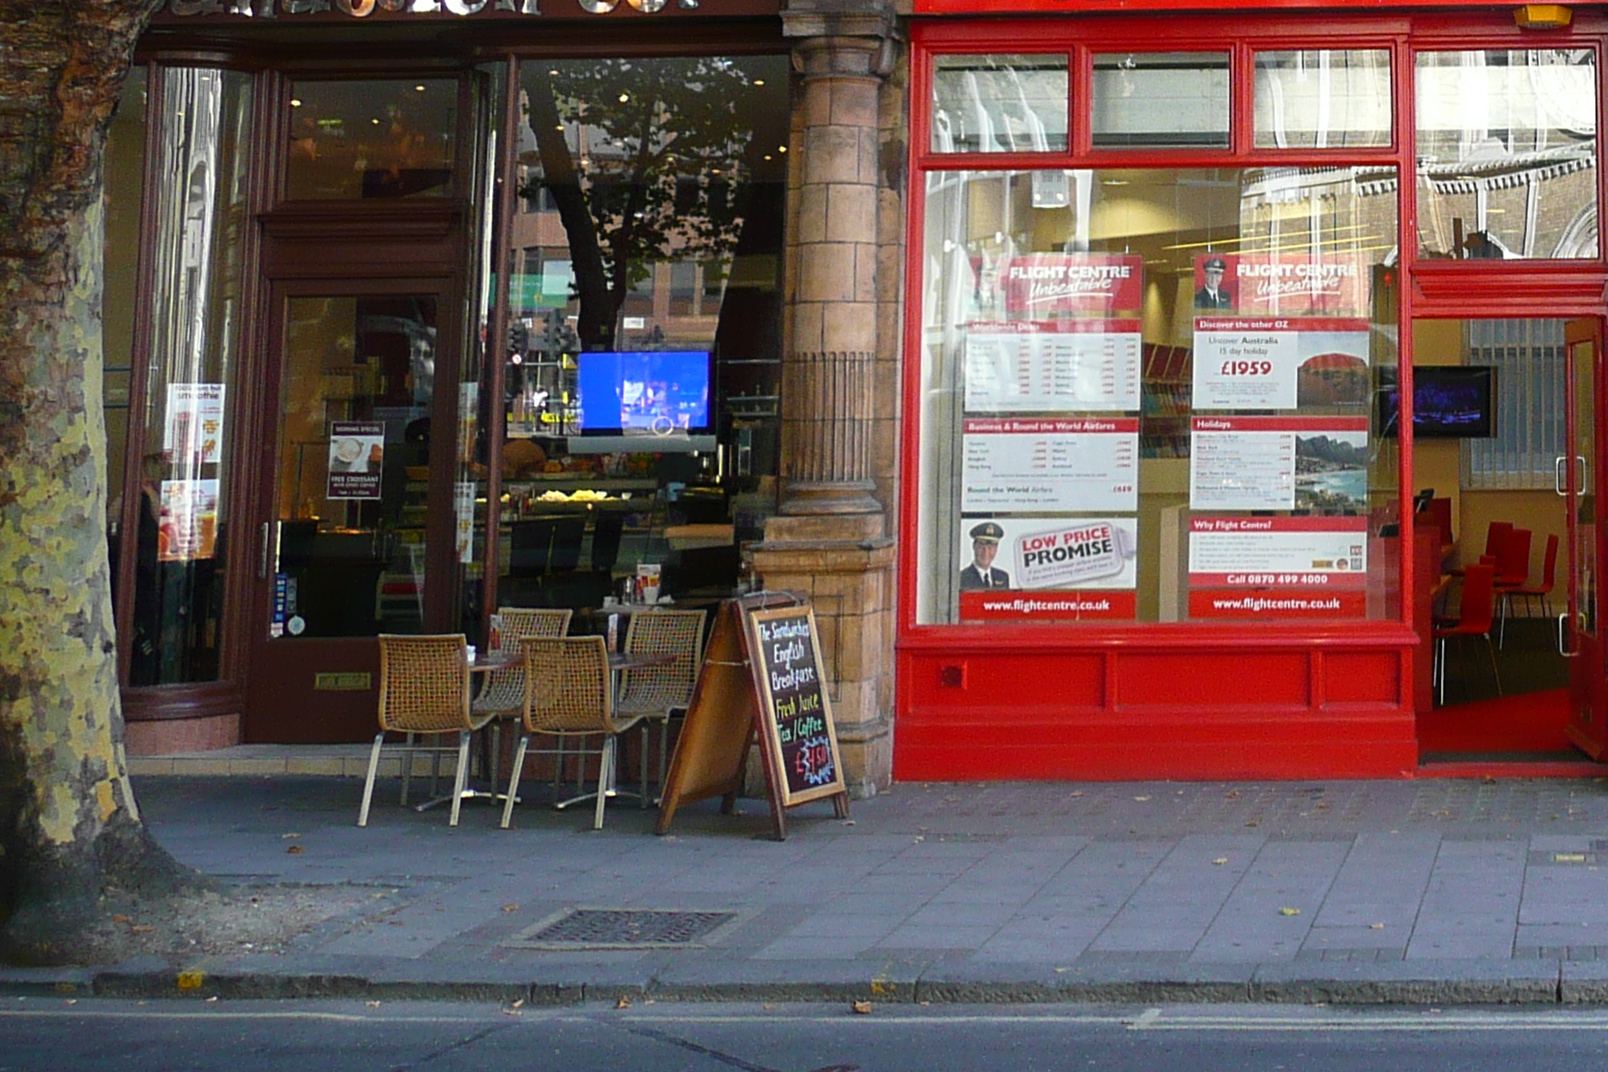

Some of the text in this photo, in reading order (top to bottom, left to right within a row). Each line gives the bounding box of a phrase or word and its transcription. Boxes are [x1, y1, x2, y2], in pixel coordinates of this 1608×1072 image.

[1009, 264, 1130, 278] FLIGHT CENTRE
[1237, 263, 1357, 277] FLIGHT CENTRE
[1030, 277, 1112, 297] Unbeatable
[1200, 320, 1234, 329] Discover
[1236, 320, 1249, 329] the
[1251, 320, 1273, 329] other
[1241, 336, 1279, 345] Australia
[1229, 347, 1241, 357] day
[1243, 347, 1268, 357] holiday
[1221, 360, 1272, 376] £1959
[1013, 422, 1039, 430] Round
[1040, 422, 1054, 430] the
[1056, 422, 1081, 430] World
[1083, 421, 1116, 430] Airfares
[1197, 419, 1231, 430] Holidays
[1194, 520, 1213, 531] Why
[1215, 520, 1238, 530] Flight
[1022, 526, 1110, 552] LOW PRICE
[1023, 538, 1113, 568] PROMISE
[1227, 573, 1328, 584] Call 0870 499 4000
[983, 599, 1110, 613] www.flightcentre.co.uk
[1213, 597, 1340, 611] www.flightcentre.co.uk
[758, 623, 771, 641] The
[773, 638, 805, 670] English
[772, 666, 814, 691] Breakfast
[776, 693, 819, 718] Fresh Juice
